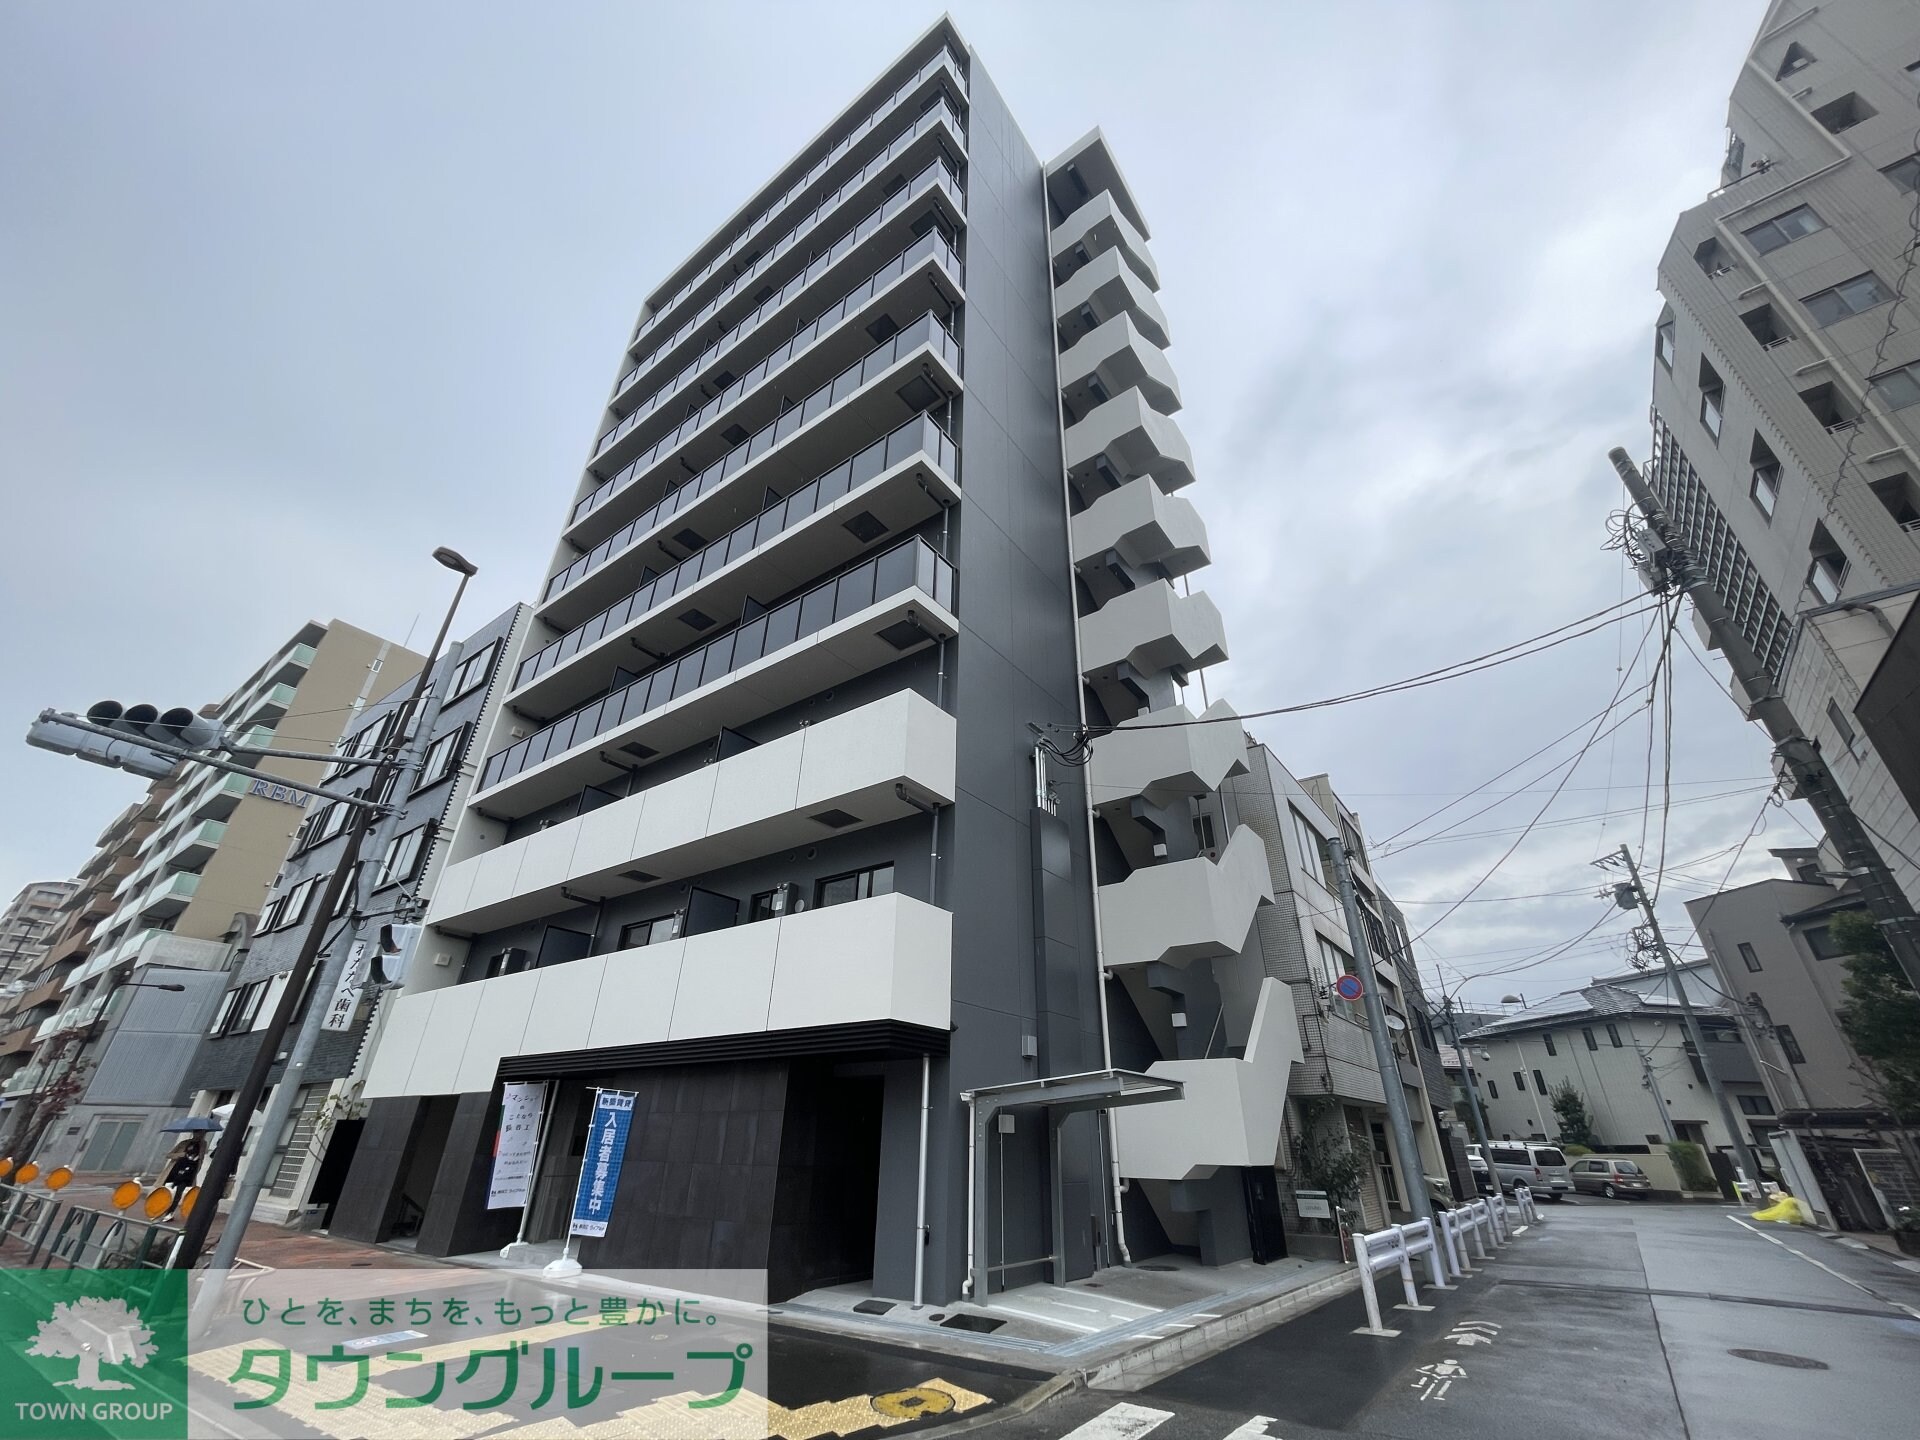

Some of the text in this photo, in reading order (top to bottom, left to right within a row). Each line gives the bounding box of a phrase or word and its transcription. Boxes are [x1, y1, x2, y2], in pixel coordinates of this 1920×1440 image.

[248, 779, 310, 808] RBM
[588, 1111, 618, 1215] 入居者募集中
